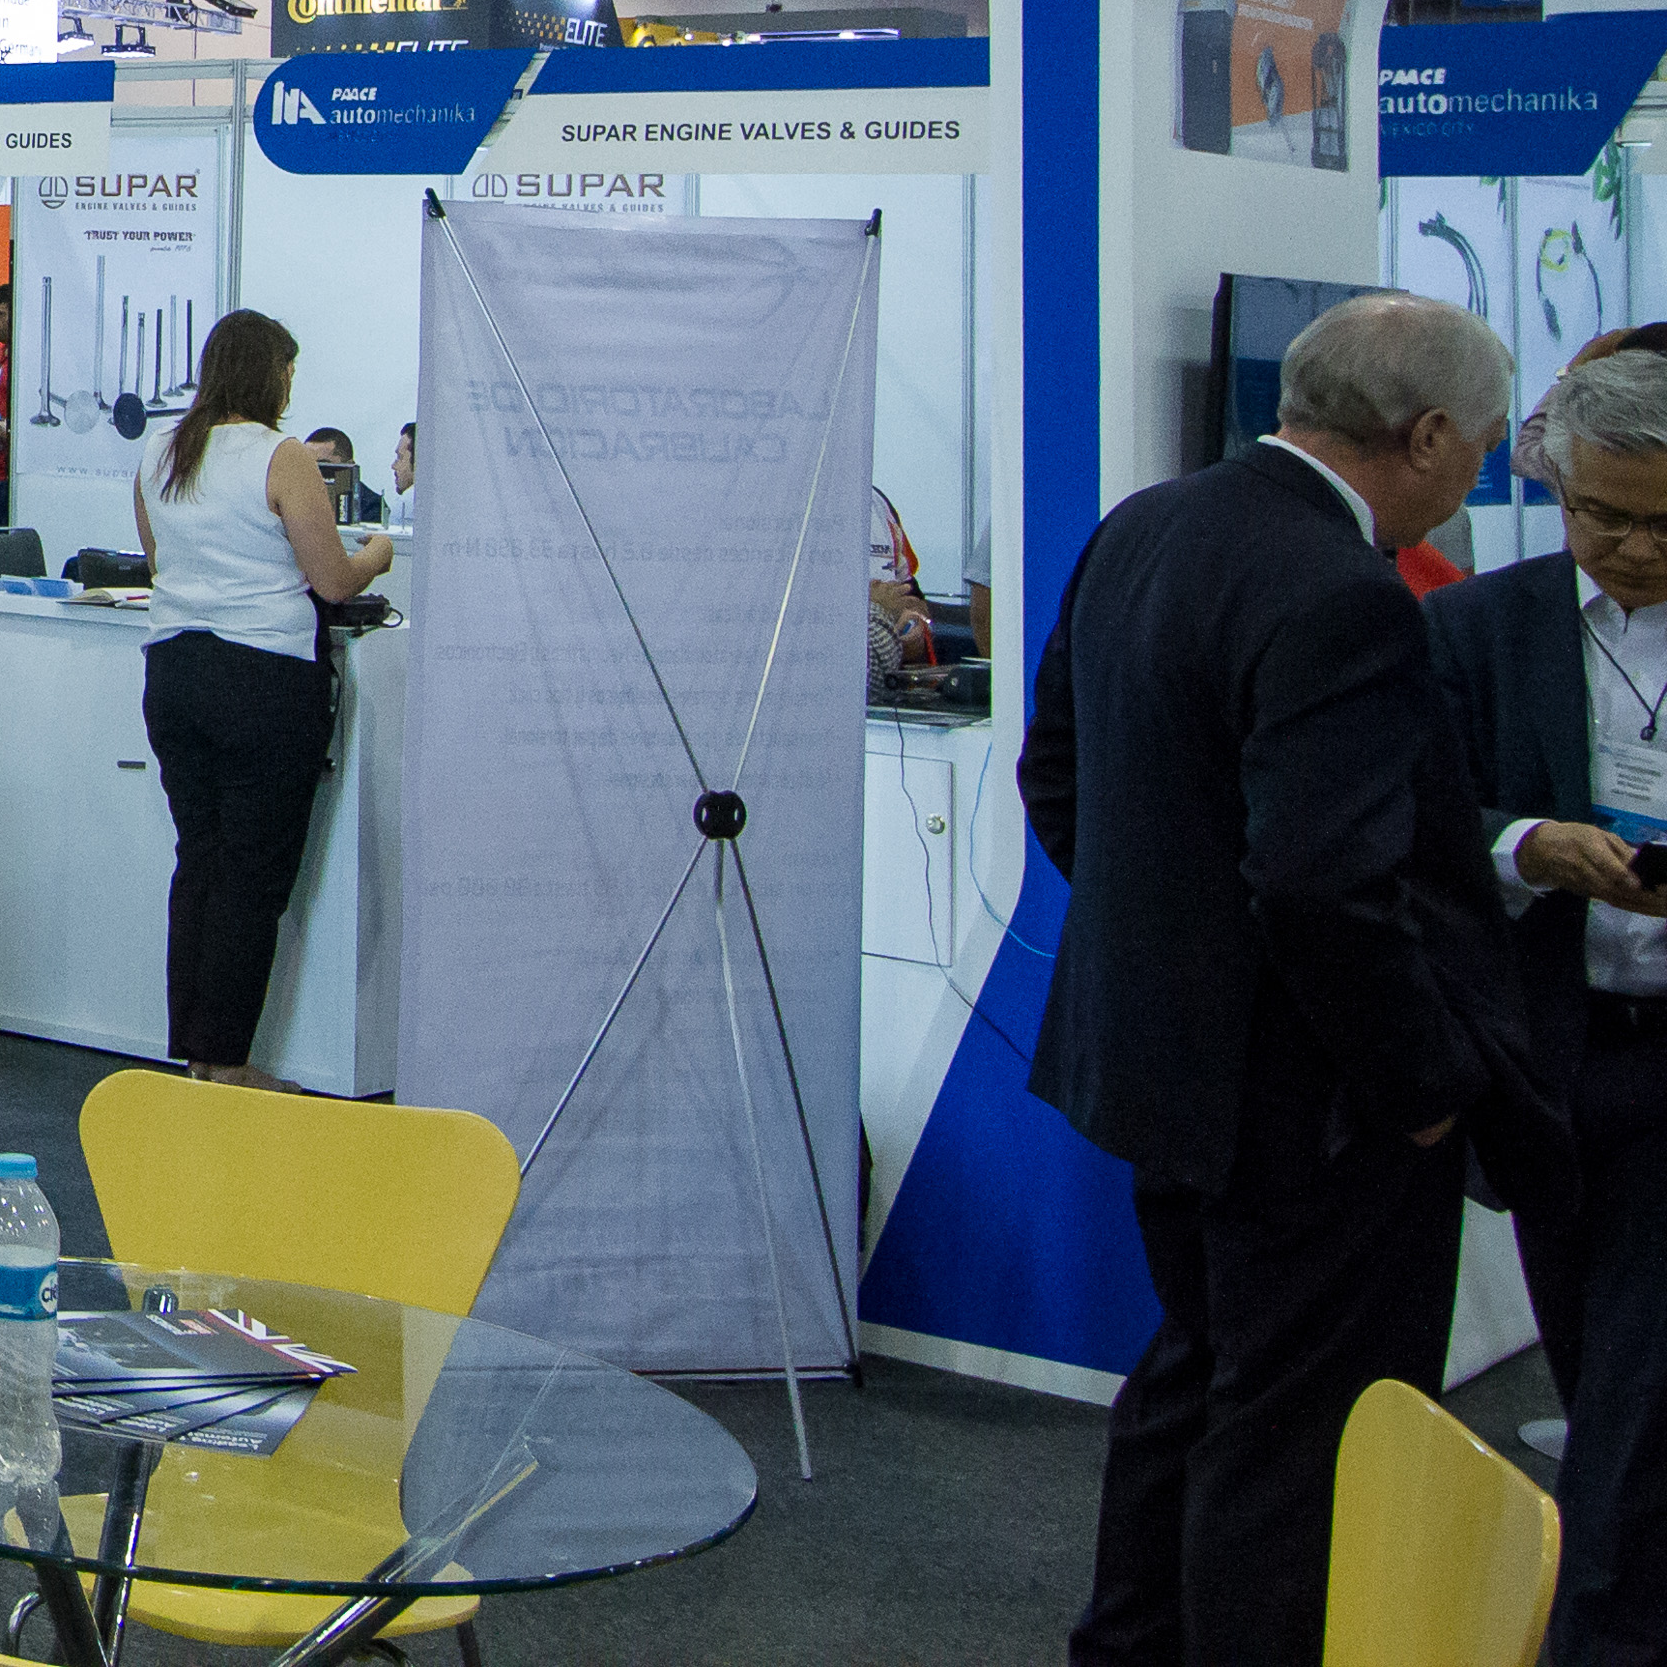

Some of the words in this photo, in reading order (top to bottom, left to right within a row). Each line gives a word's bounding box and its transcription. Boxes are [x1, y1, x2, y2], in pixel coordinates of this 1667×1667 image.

[1378, 68, 1447, 85] PAACE
[332, 87, 377, 101] PAACE
[1378, 86, 1599, 114] automechanika
[330, 103, 475, 124] automechanika
[8, 132, 72, 149] GUIDES
[562, 124, 637, 143] SUPAR
[645, 123, 732, 142] ENGINE
[740, 122, 831, 140] VALVES
[839, 122, 856, 140] &
[865, 121, 961, 139] GUIDES
[74, 174, 198, 198] SUPAR
